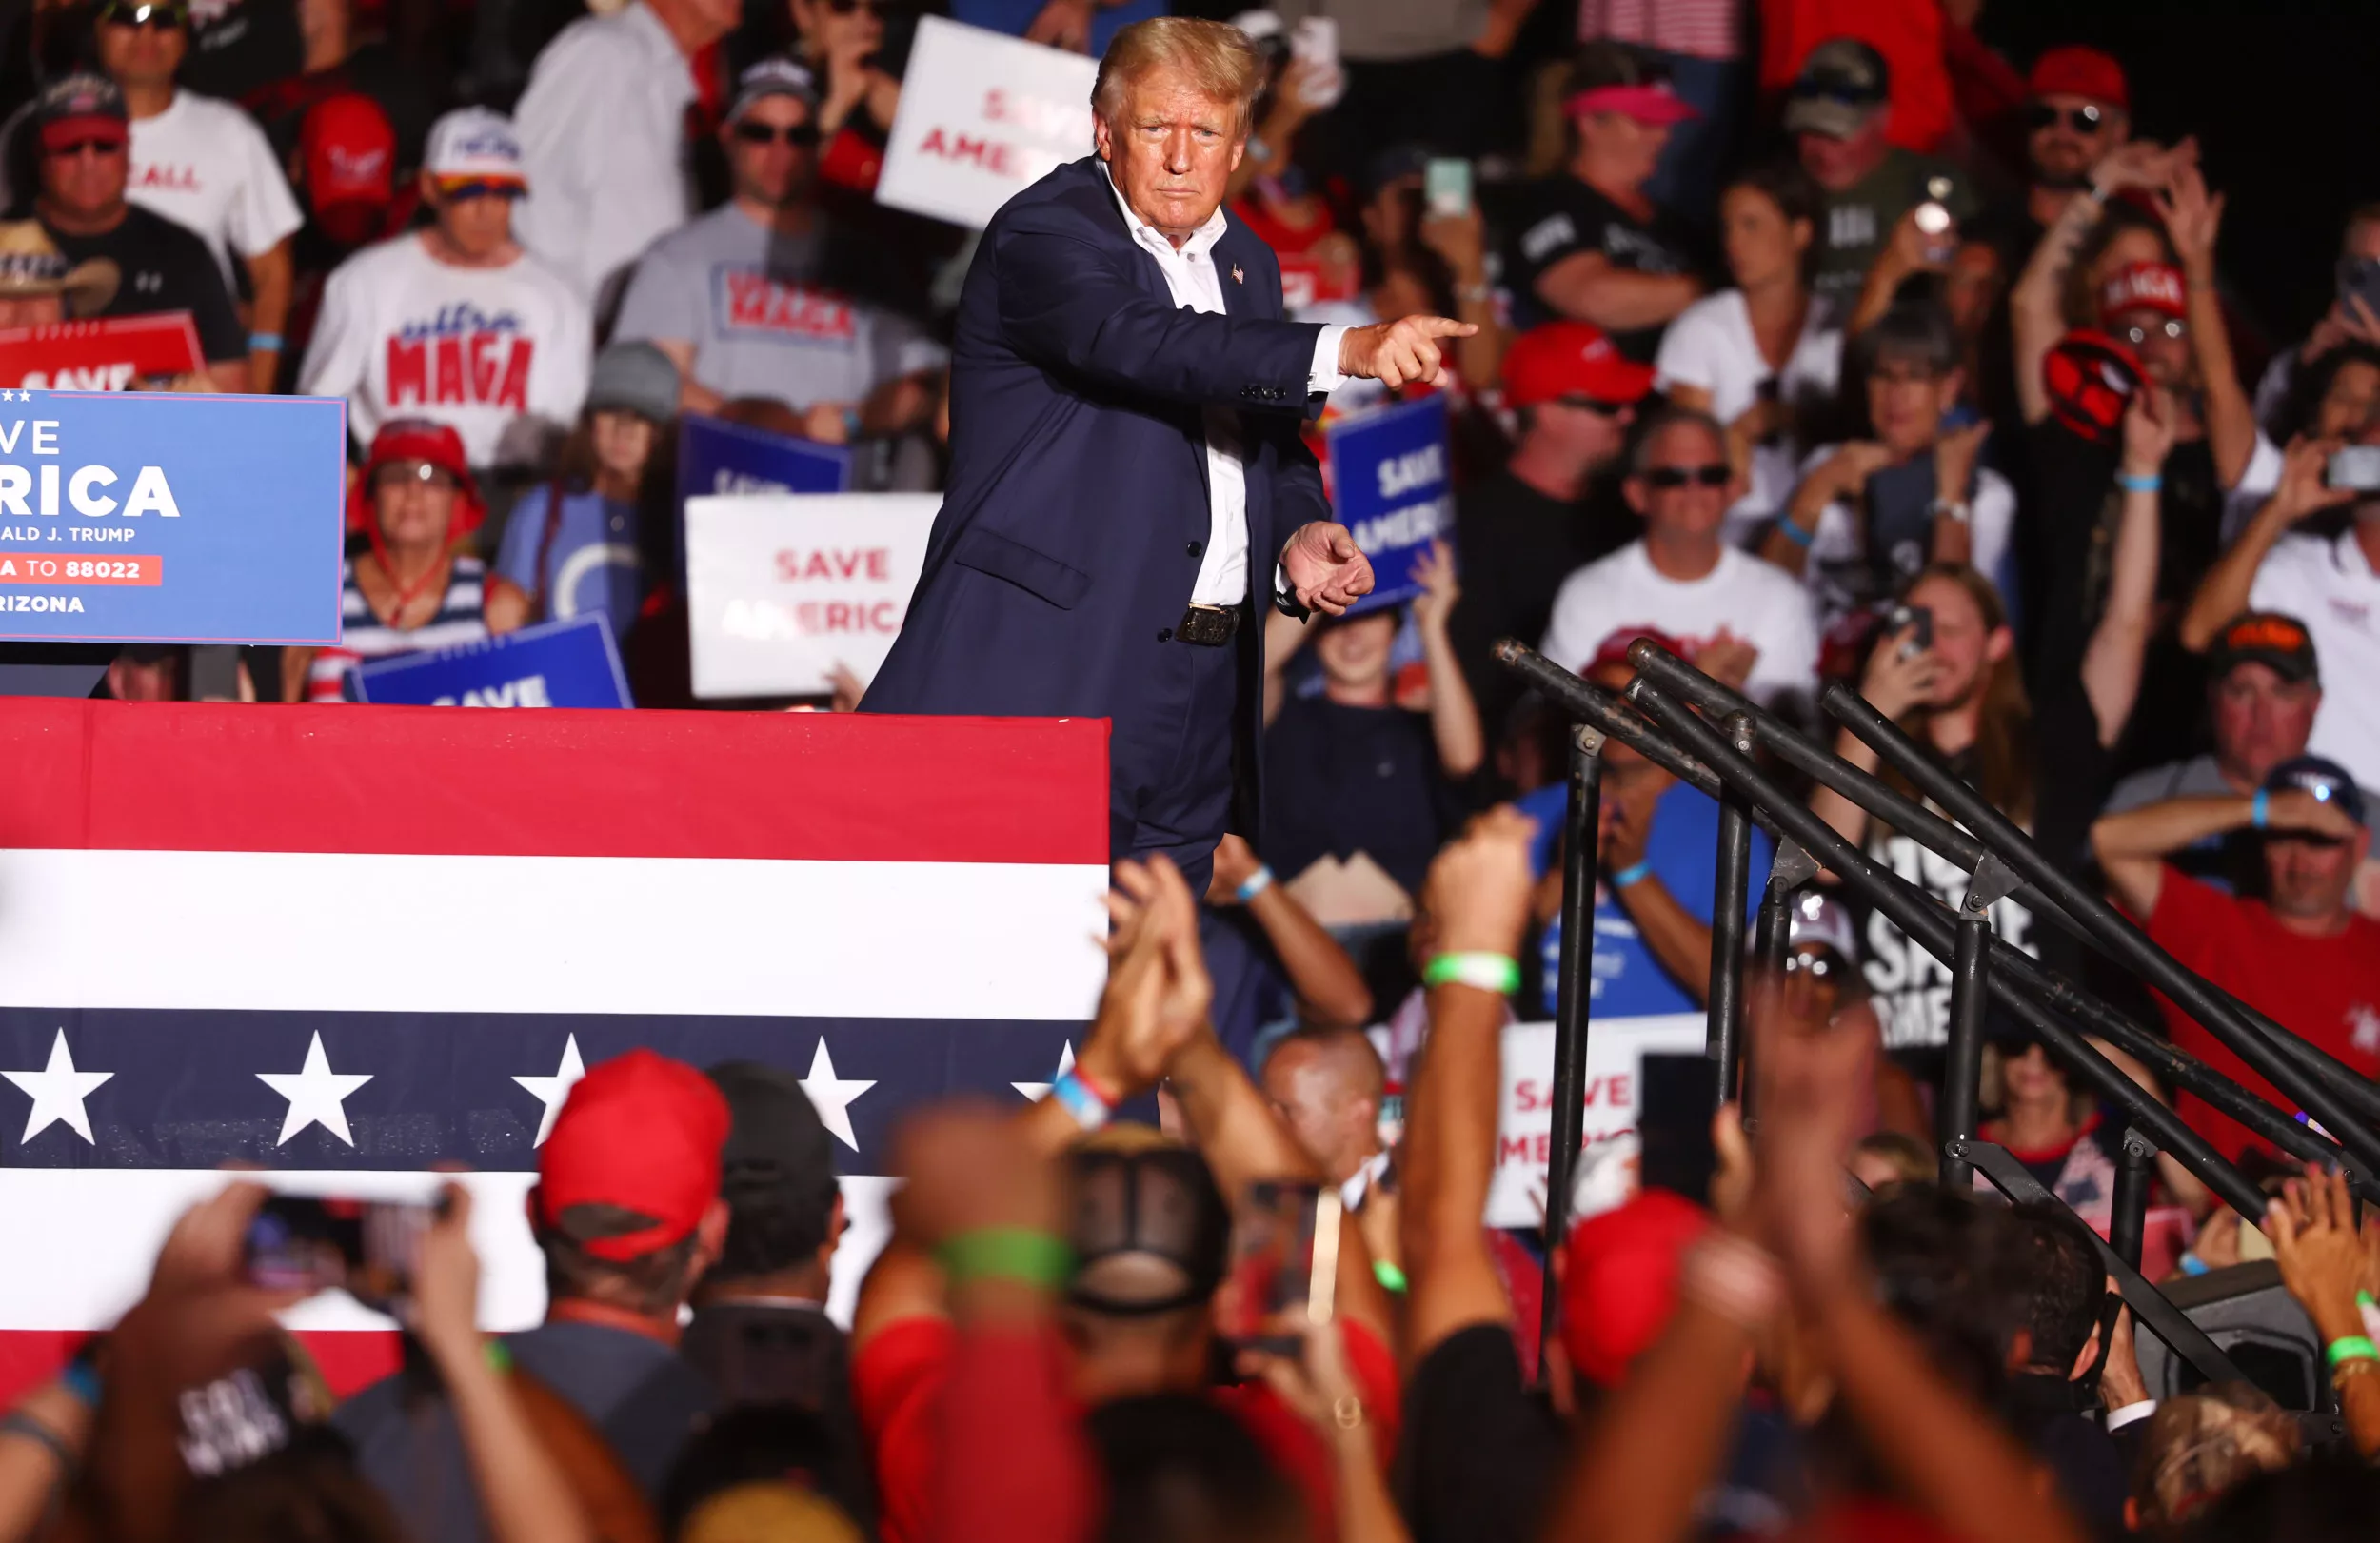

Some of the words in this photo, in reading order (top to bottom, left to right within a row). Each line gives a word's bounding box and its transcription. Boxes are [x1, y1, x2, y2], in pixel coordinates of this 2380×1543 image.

[386, 330, 533, 414] MAGA
[0, 465, 181, 518] RICA
[0, 526, 41, 542] ALD
[47, 527, 63, 542] J.
[69, 527, 136, 543] TRUMP
[26, 560, 58, 577] TO
[65, 561, 141, 579] 88022
[775, 547, 890, 581] SAVE
[721, 600, 902, 637] AMERIC
[1861, 893, 2041, 993] SAE
